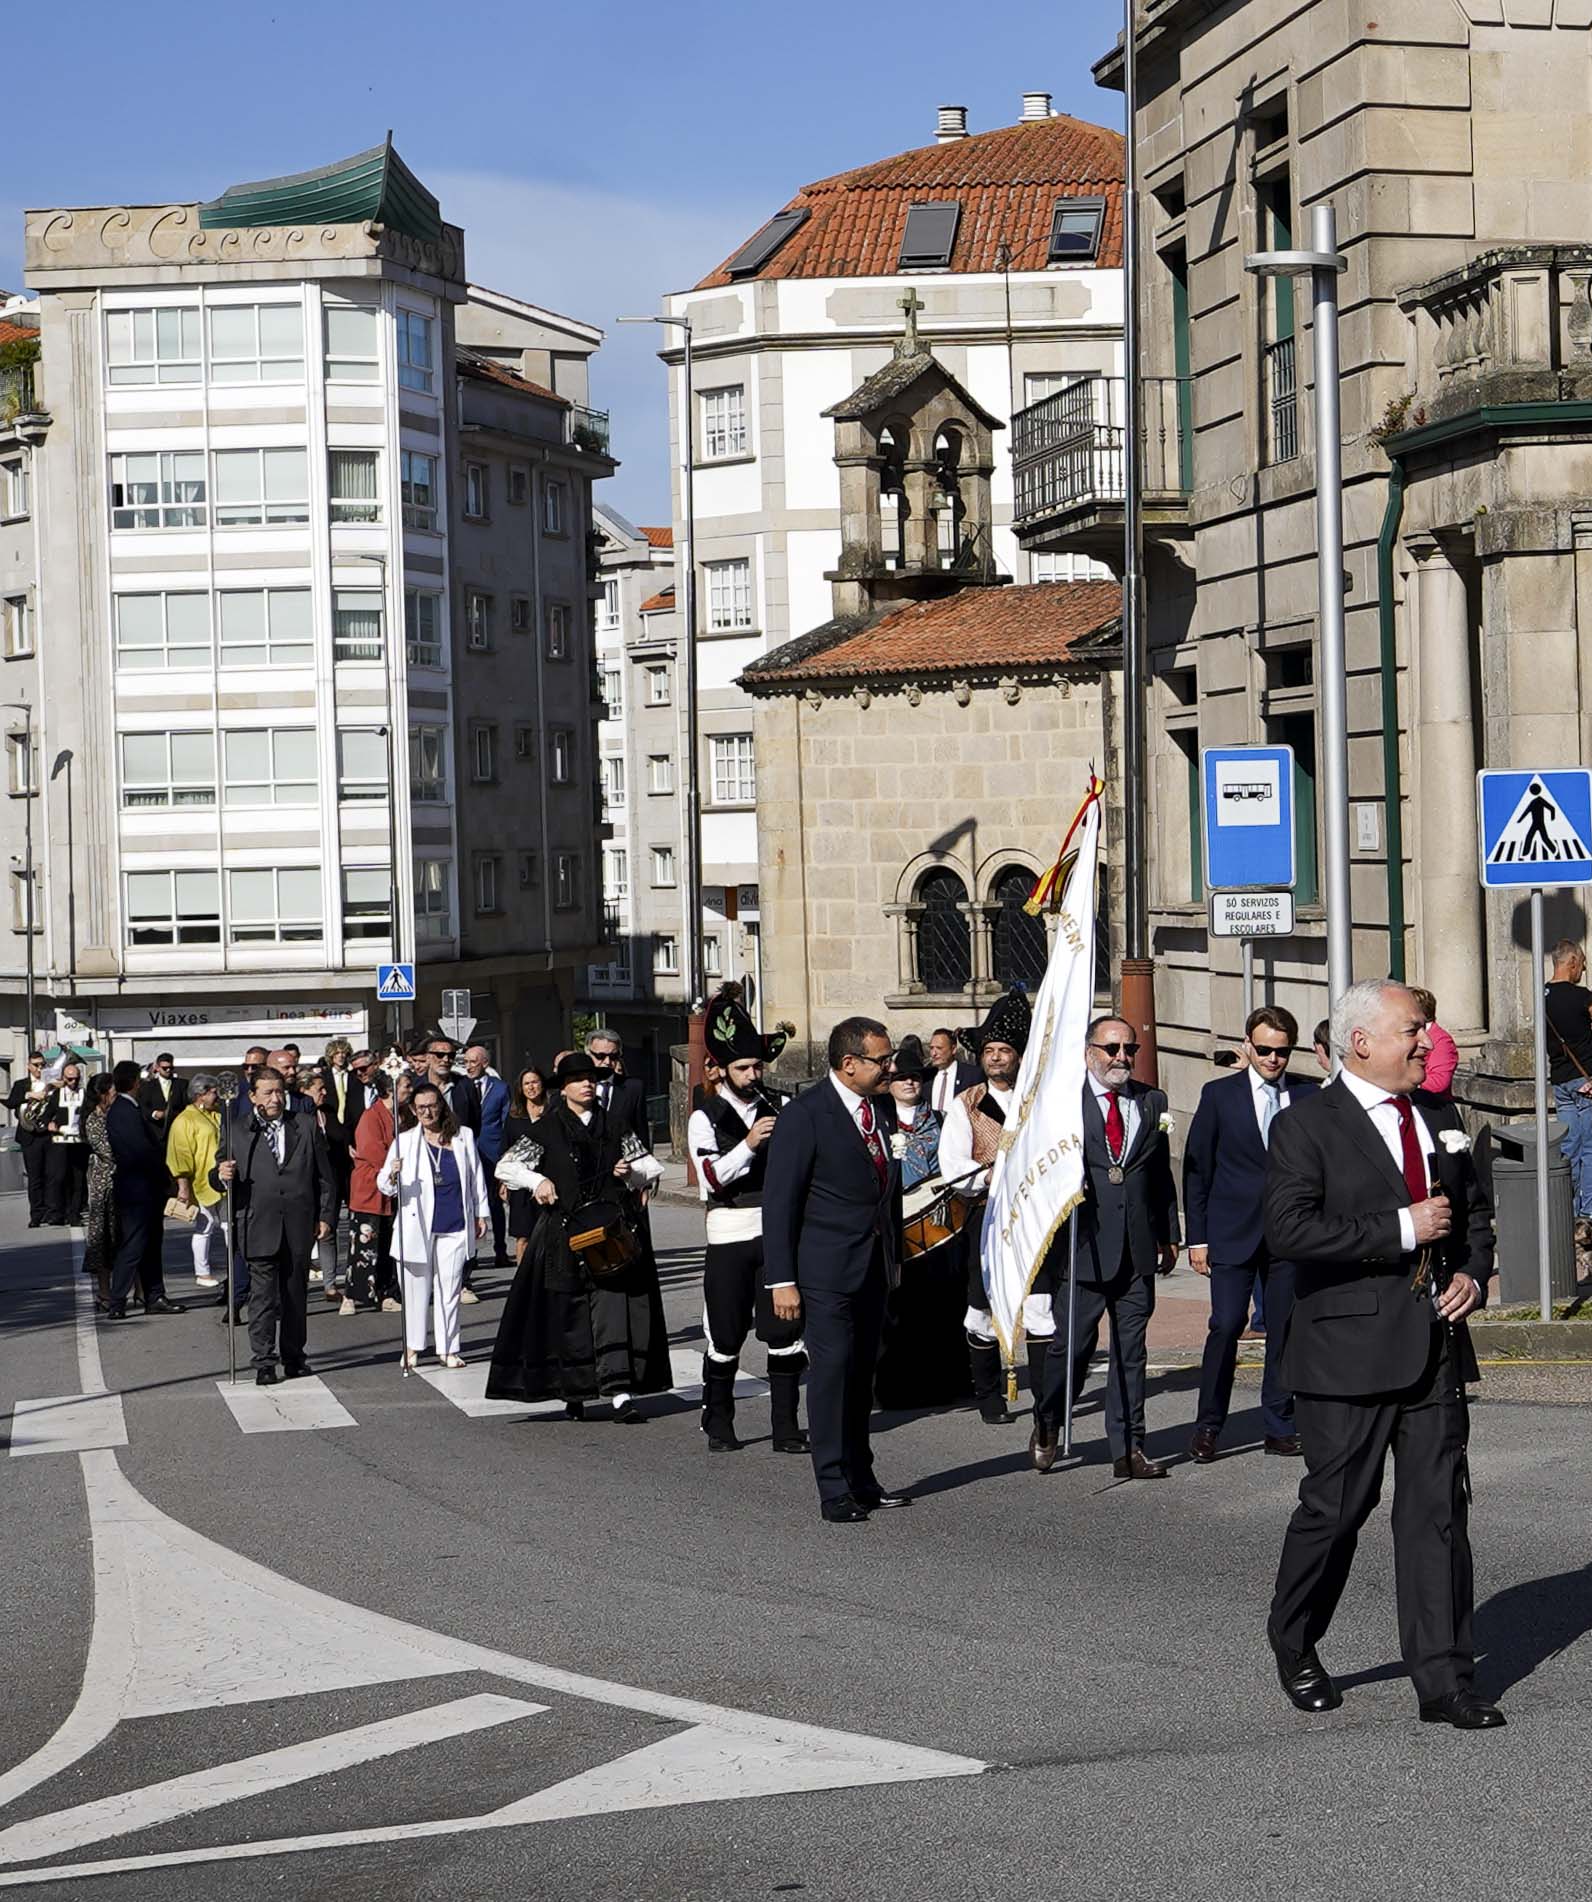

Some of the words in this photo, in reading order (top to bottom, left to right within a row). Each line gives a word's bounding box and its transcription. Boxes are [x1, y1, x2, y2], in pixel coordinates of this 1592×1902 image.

[1226, 897, 1237, 908] SÓ
[1240, 897, 1279, 908] SERVIZOS
[1225, 911, 1272, 921] REGULARES
[1275, 910, 1281, 920] E
[1230, 923, 1276, 934] ESCOLARES
[148, 1011, 209, 1025] Viaxes
